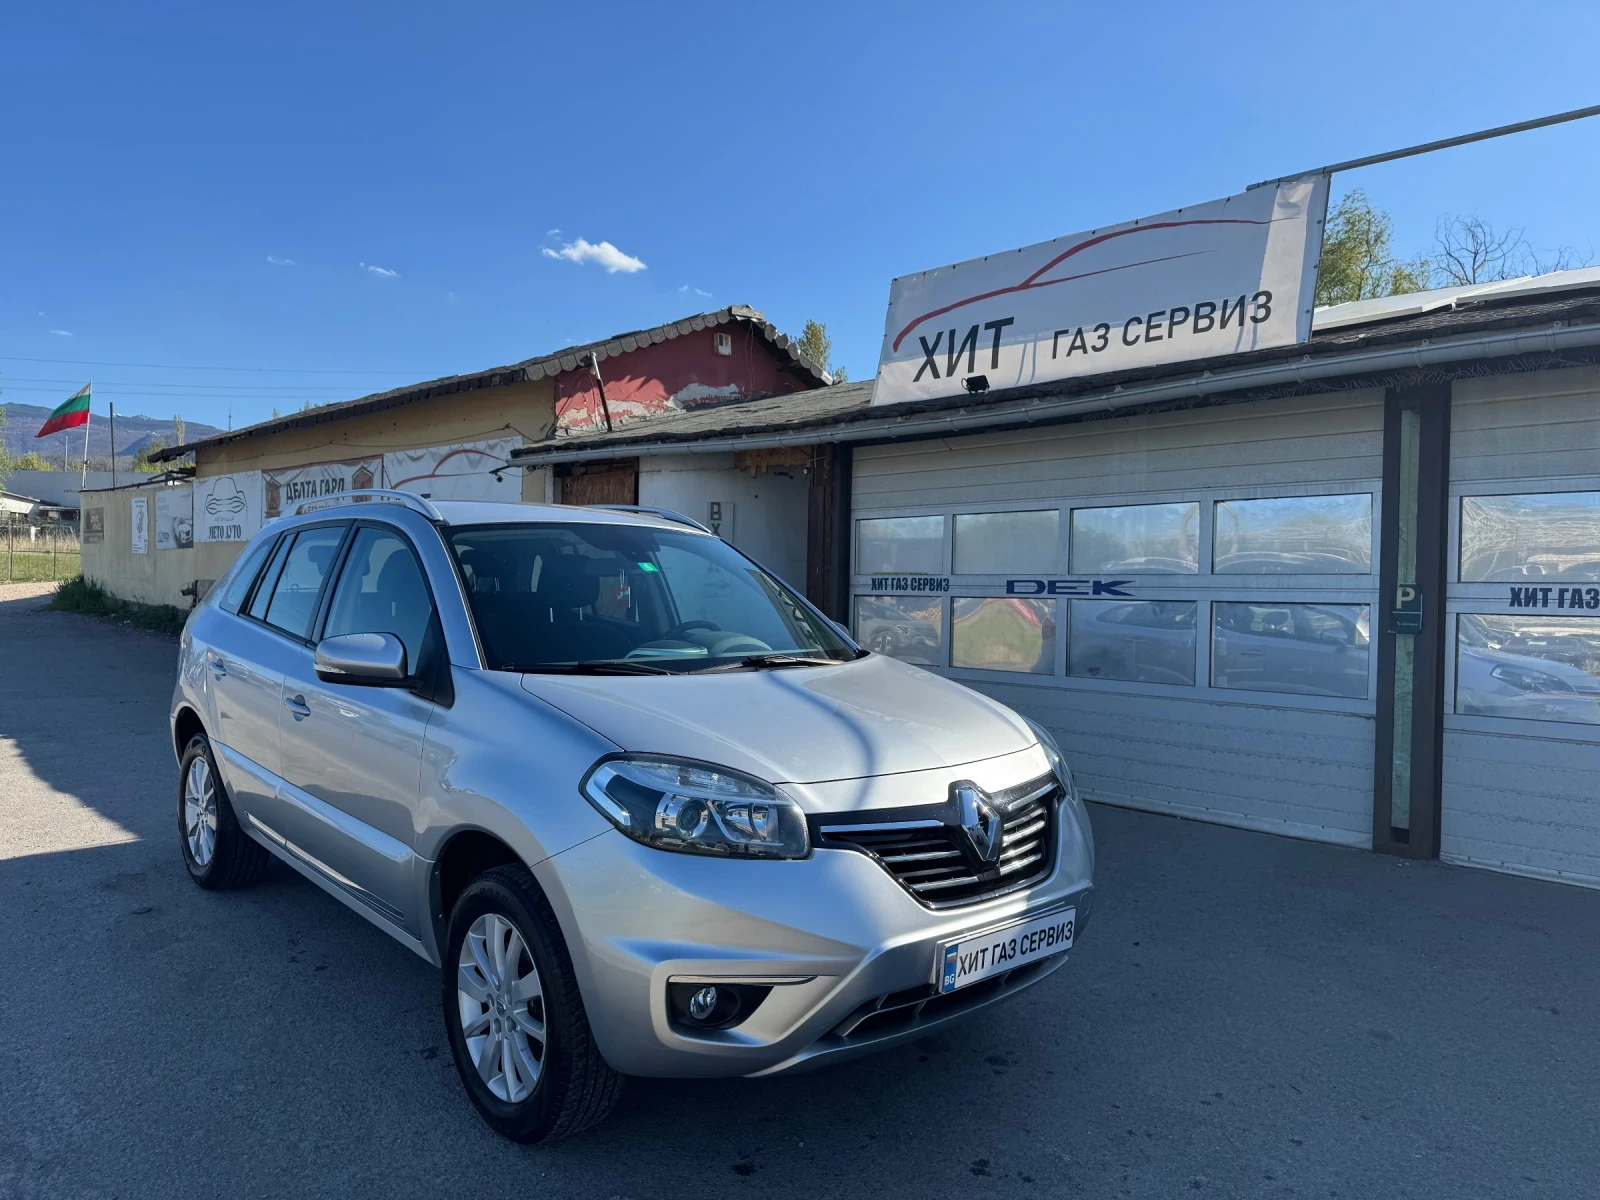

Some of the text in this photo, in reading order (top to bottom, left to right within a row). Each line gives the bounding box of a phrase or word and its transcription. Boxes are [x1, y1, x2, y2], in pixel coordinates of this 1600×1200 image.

[913, 290, 1273, 383] ХИТ ГАЗ СЕРВИЗ
[286, 479, 317, 504] ДЕЛТА
[871, 577, 950, 592] ХИТ ГАЗ СЕРВИЗ
[1006, 580, 1137, 596] DEK
[1396, 587, 1415, 609] P
[1509, 587, 1600, 610] ХИТ ГАЗ
[957, 920, 1074, 978] ХИТ ГАЗ СЕРВИЗ
[944, 974, 955, 986] BG
